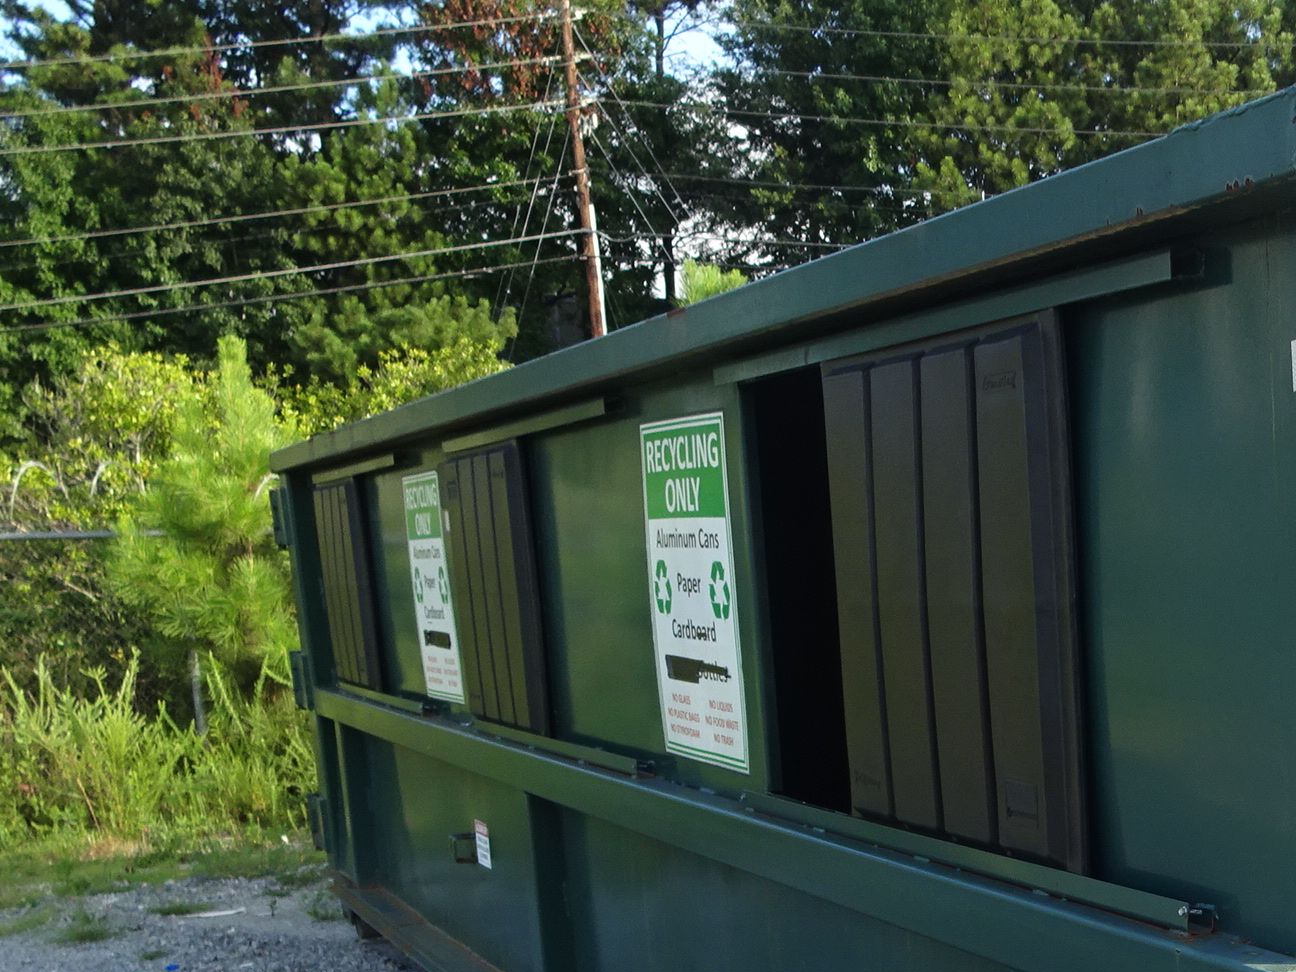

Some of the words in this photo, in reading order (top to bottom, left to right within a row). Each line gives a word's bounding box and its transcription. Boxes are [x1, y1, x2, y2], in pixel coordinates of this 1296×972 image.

[646, 432, 719, 473] RECYCLING
[665, 477, 700, 513] ONLY
[656, 529, 697, 548] Aluminum
[699, 528, 719, 549] Cans
[677, 572, 701, 598] Paper
[672, 619, 717, 642] Cardboard
